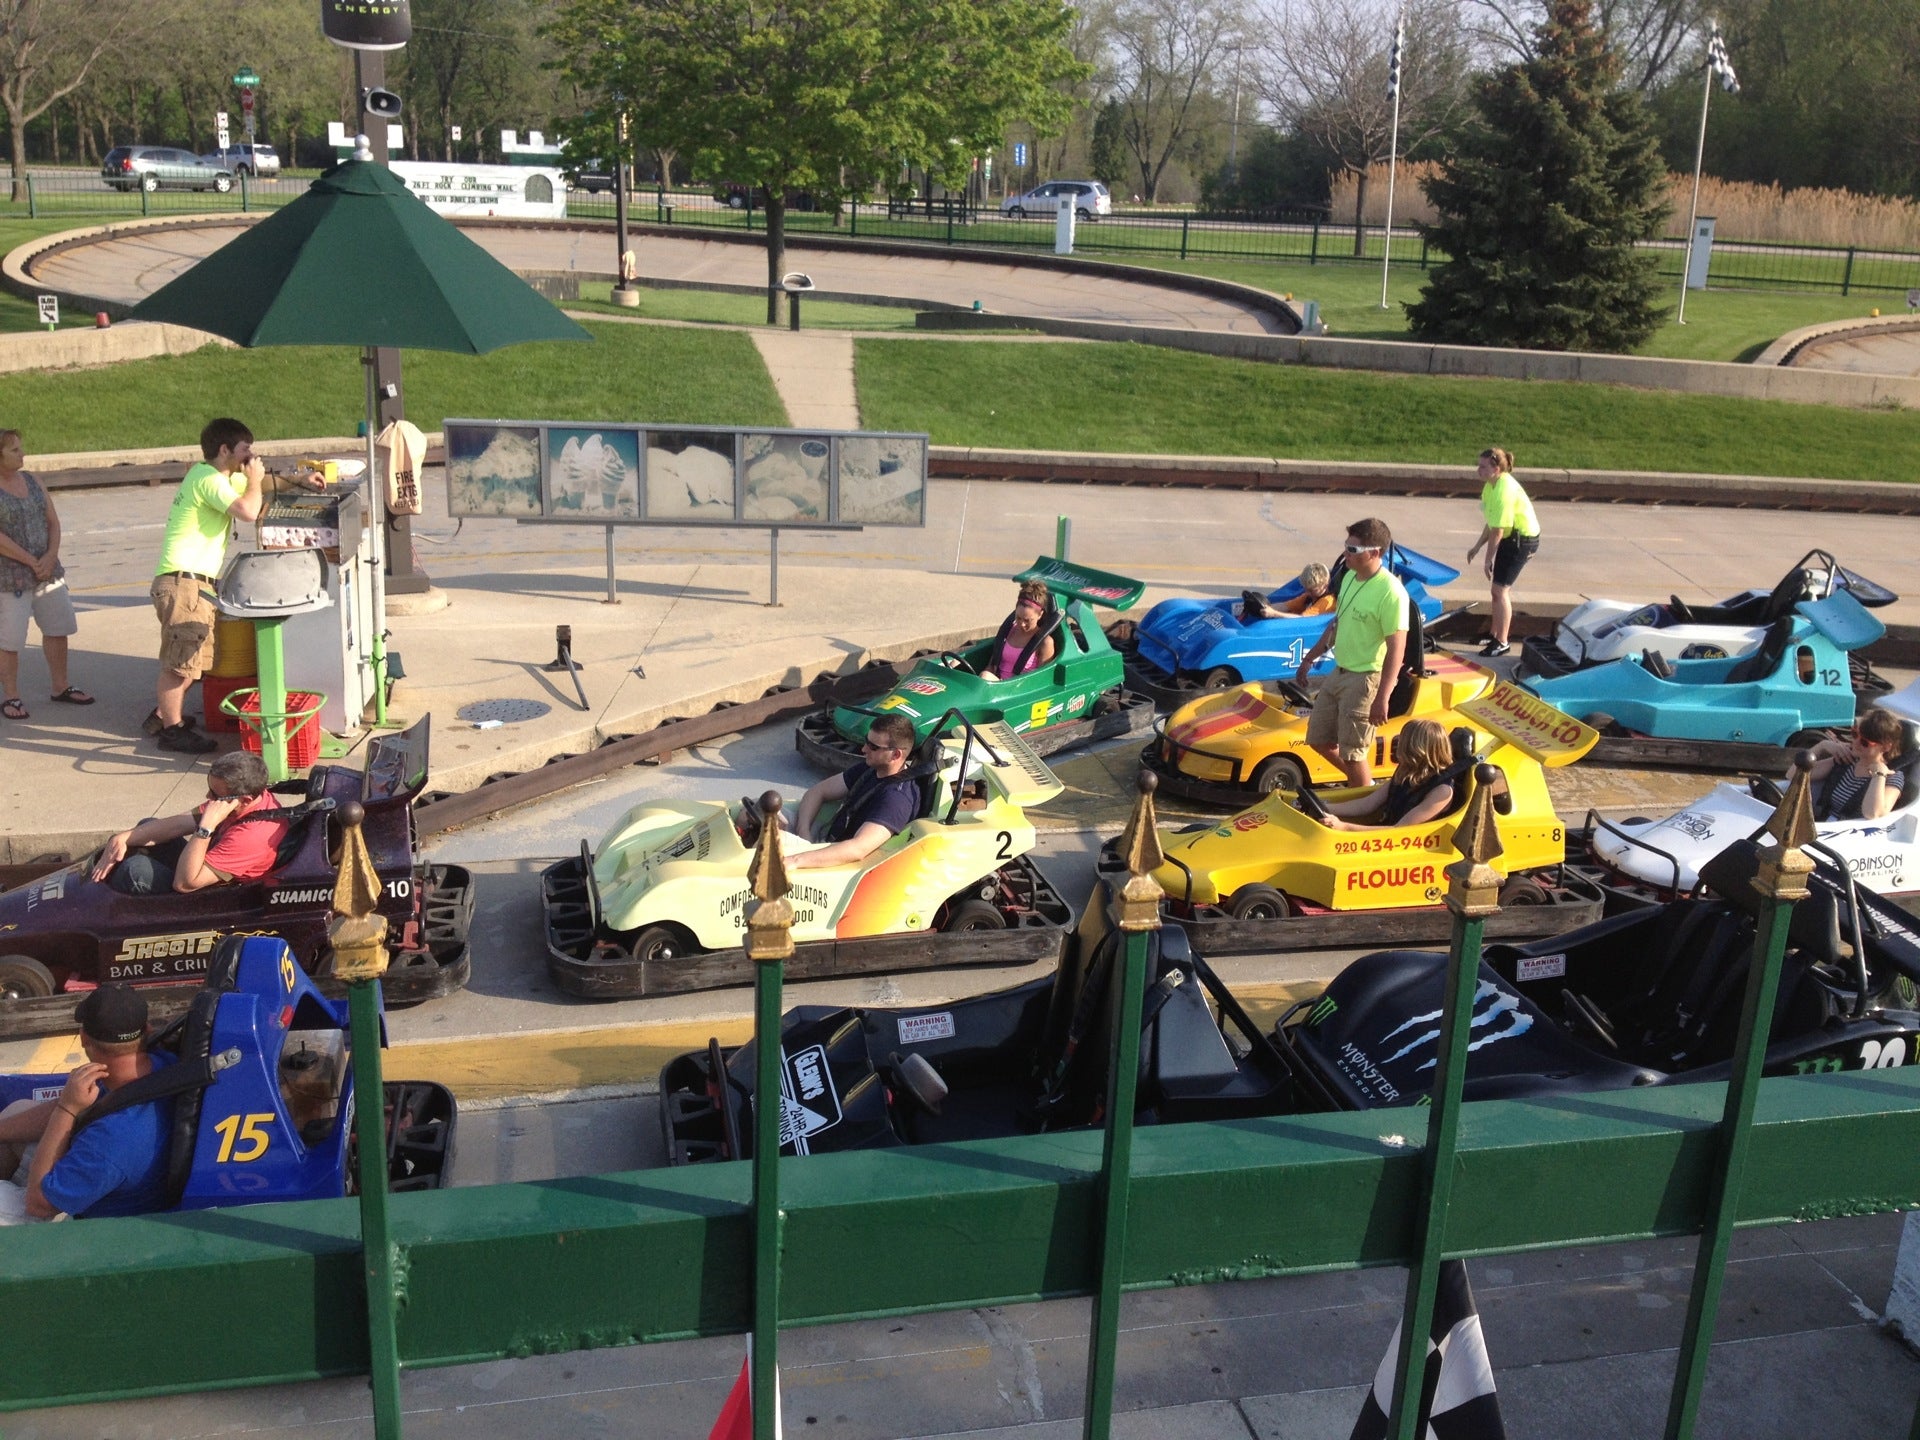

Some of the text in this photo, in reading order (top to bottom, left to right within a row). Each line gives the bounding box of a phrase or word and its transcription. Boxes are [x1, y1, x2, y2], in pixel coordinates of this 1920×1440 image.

[334, 3, 399, 14] ENERGY
[434, 182, 452, 190] ROCK
[461, 183, 492, 191] CLIMBING
[440, 175, 477, 184] TRY OUR
[433, 195, 447, 203] YOU
[395, 470, 414, 485] FIRE
[1818, 668, 1842, 687] 12
[1030, 700, 1050, 729] 9
[1488, 686, 1550, 731] FLOWER
[1335, 834, 1441, 854] 920 434-9461
[1551, 828, 1561, 842] 8
[996, 831, 1012, 860] 2
[1616, 845, 1631, 856] 7
[1848, 853, 1903, 873] OBINSON
[1347, 866, 1435, 891] FLOWER
[386, 880, 410, 899] 10
[720, 883, 828, 918] COMFOR SULATORS
[110, 958, 207, 979] BAR & GRIL
[1523, 957, 1560, 968] WARNING
[905, 1015, 947, 1027] WARNING
[1336, 1059, 1377, 1100] ENERGY
[213, 1112, 276, 1163] 15
